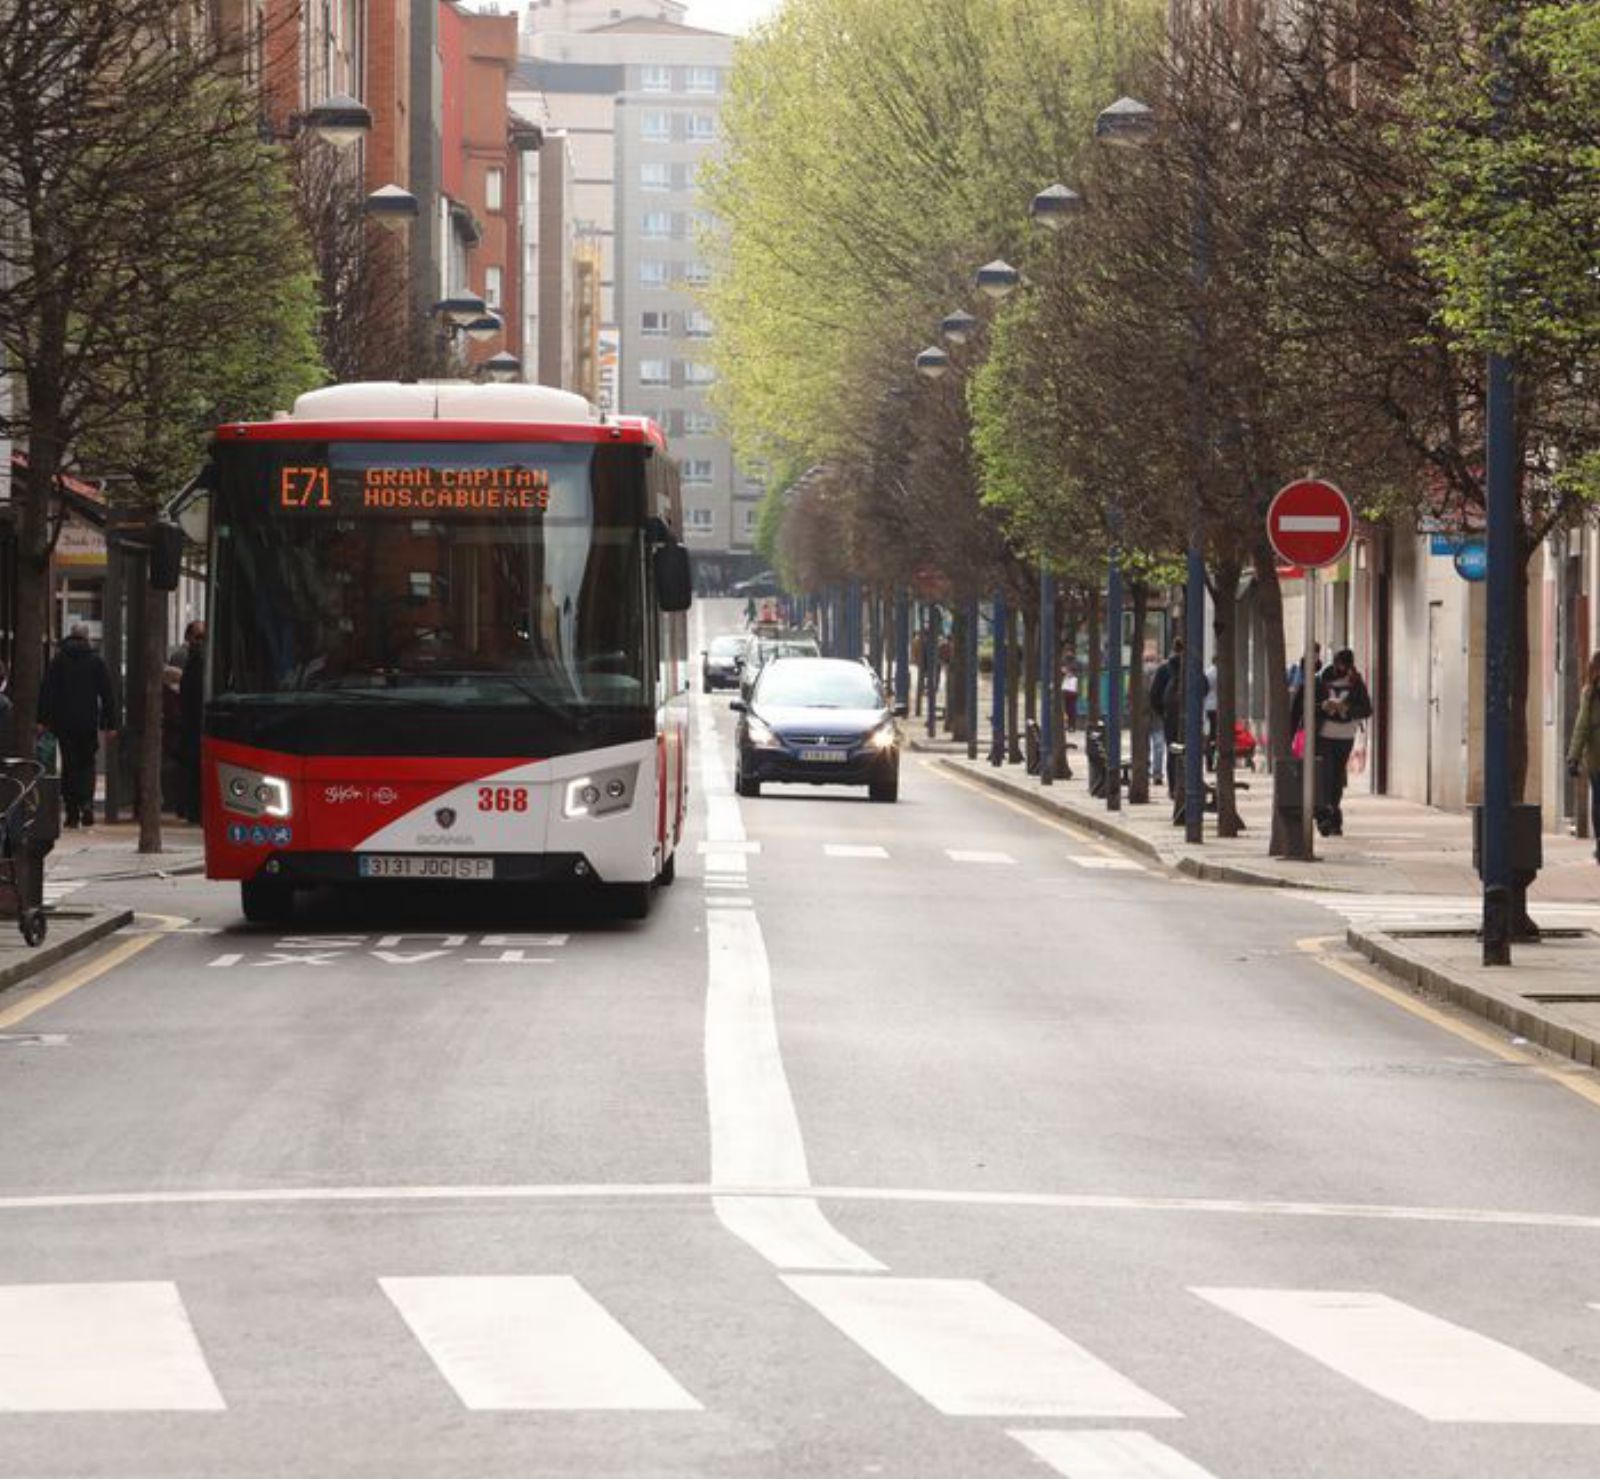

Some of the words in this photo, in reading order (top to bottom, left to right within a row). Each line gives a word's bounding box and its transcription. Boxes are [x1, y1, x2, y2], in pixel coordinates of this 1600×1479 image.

[366, 468, 430, 486] GRAN
[441, 468, 548, 486] CAPITAN
[281, 467, 332, 506] E71
[477, 788, 528, 812] 368
[371, 859, 411, 875] 3131
[273, 933, 571, 949] BUS
[207, 949, 556, 967] TAXI
